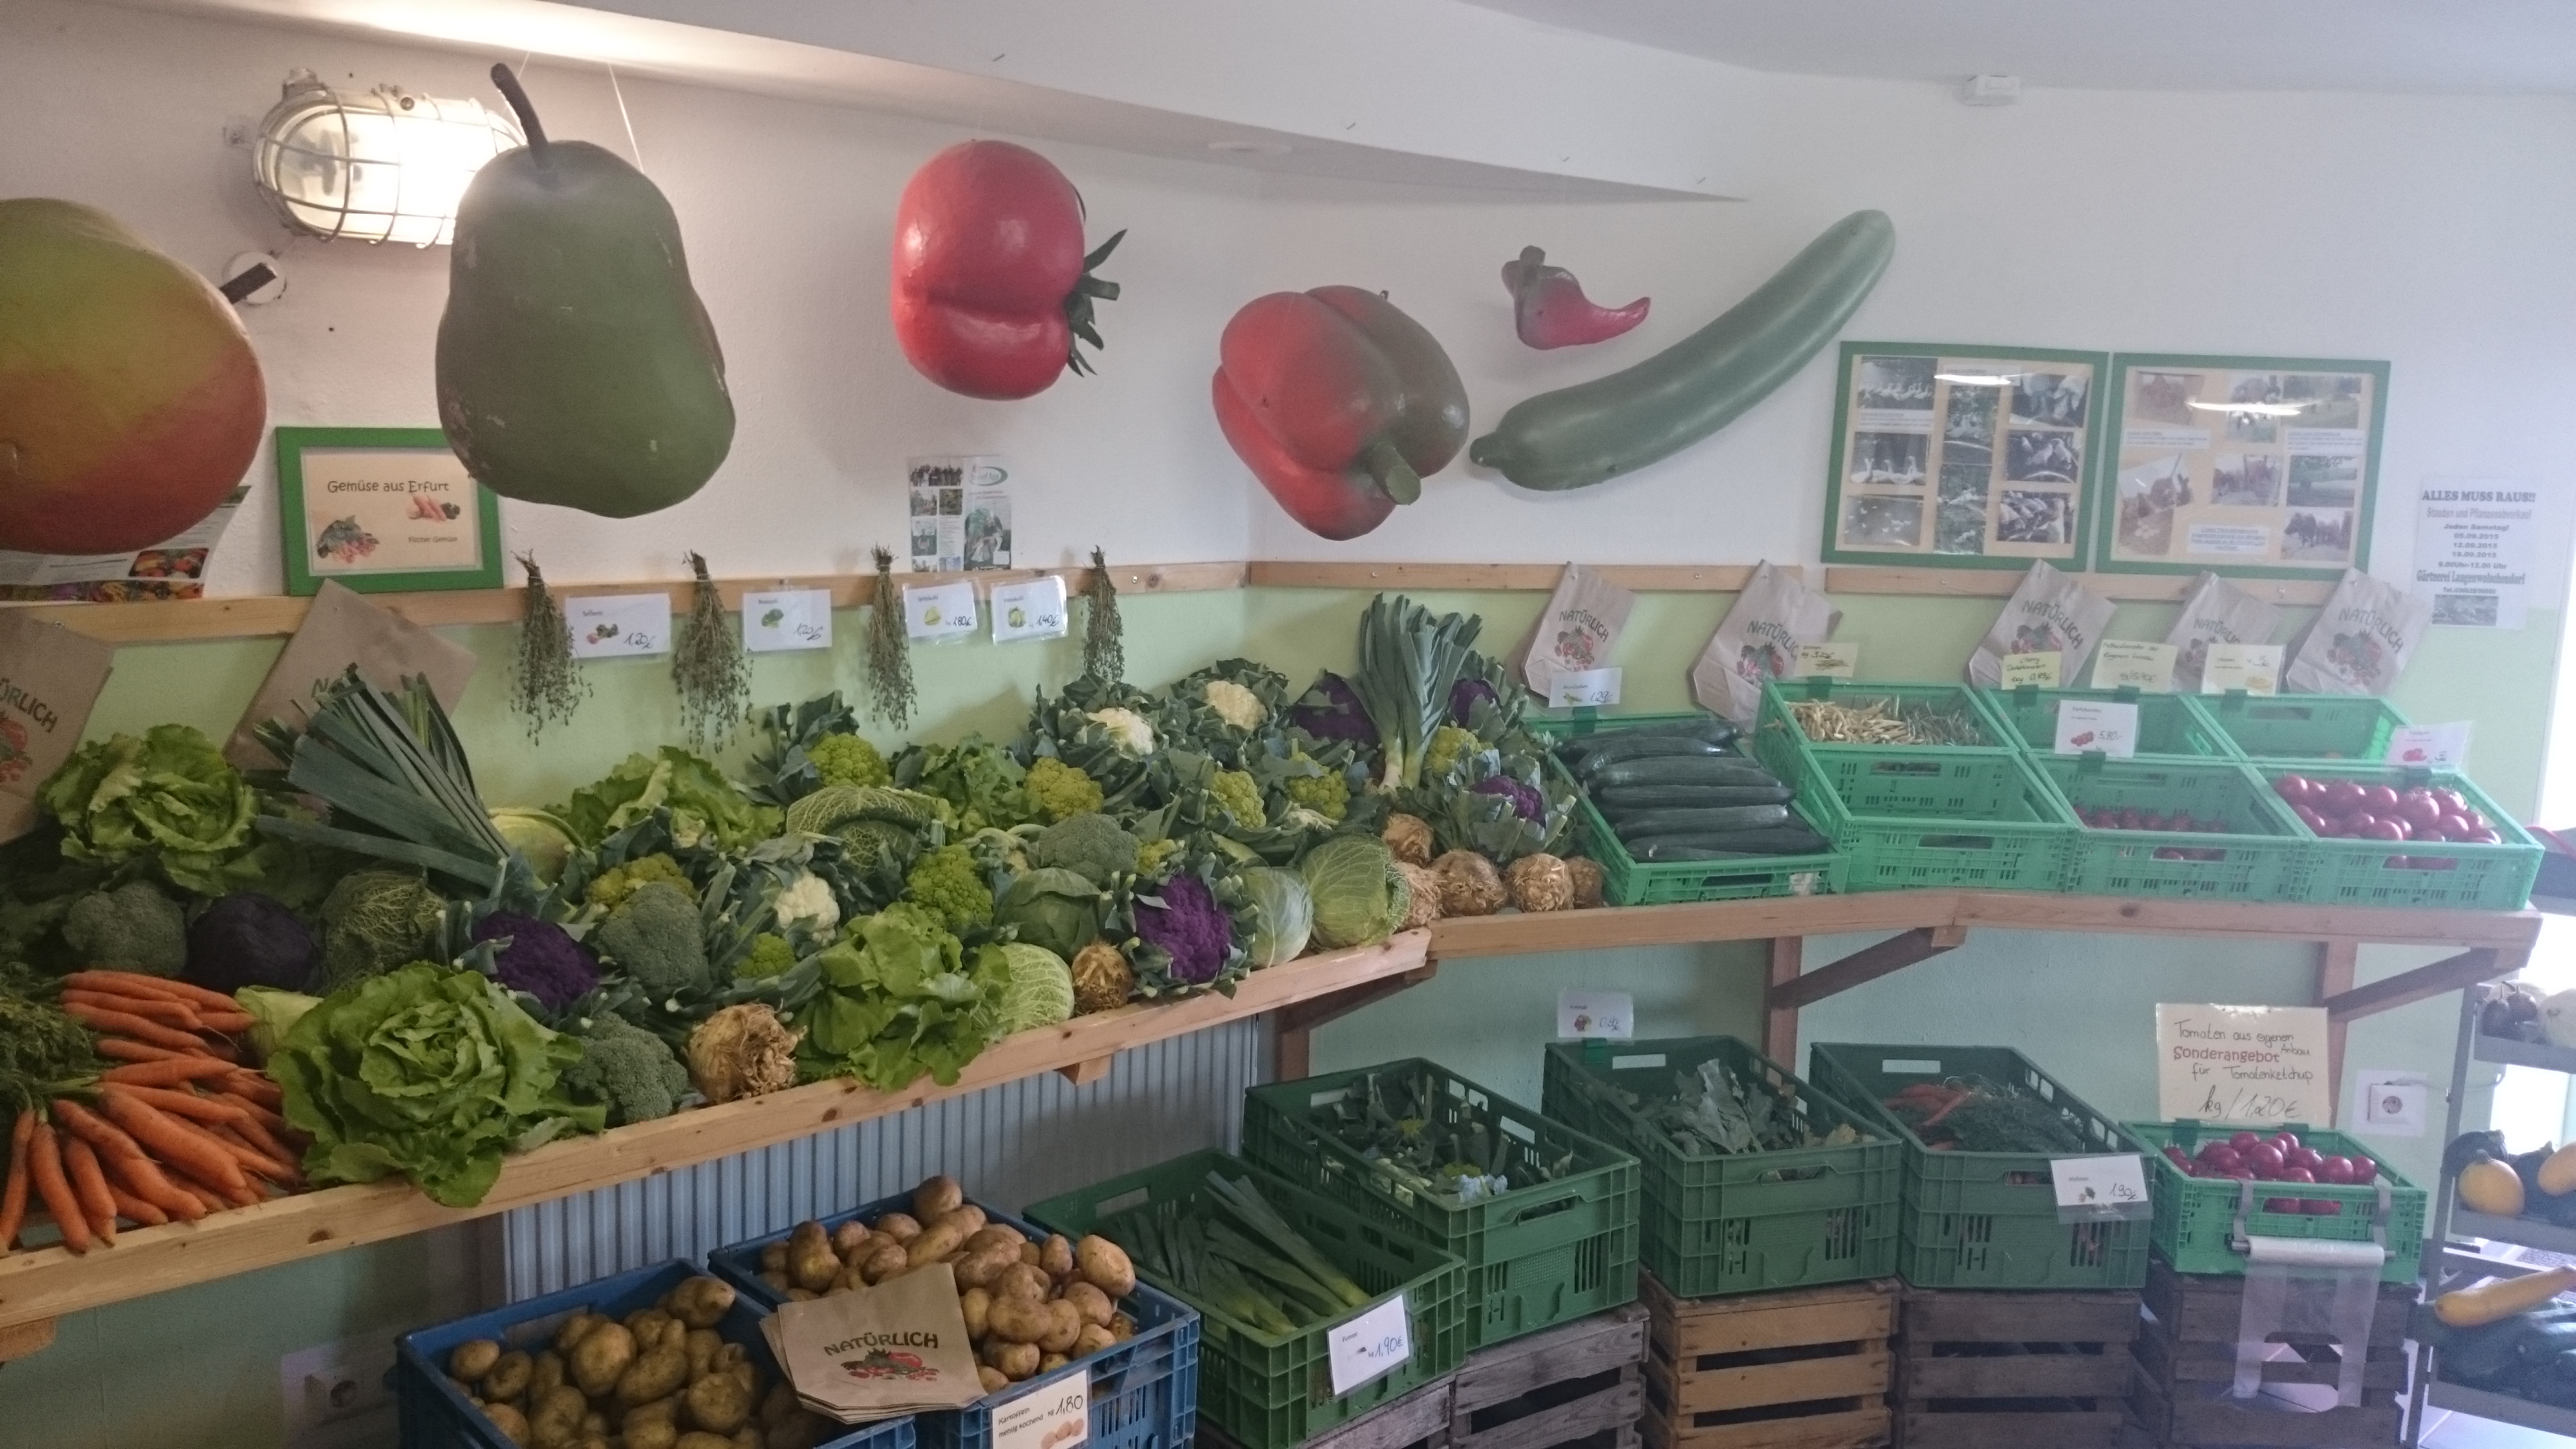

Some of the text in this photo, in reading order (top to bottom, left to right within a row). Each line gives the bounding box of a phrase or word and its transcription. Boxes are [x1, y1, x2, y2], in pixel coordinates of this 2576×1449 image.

[327, 480, 450, 493] Gemüse aus Erfurt
[2422, 490, 2536, 502] ALLES MUSS RAUS!!
[2455, 508, 2469, 519] und
[2416, 570, 2451, 582] Gärtnerei
[1559, 609, 1609, 643] NATÜRLICH
[2021, 600, 2084, 650] NATÜRLICH
[2194, 617, 2241, 644] NATÜRLI
[2338, 607, 2404, 654] NATÜRLICH
[1746, 620, 1799, 662] NATÜRLIC
[2174, 1018, 2294, 1048] Tomaten aus eigenem
[2174, 1046, 2280, 1063] Sonderangebot
[2282, 1043, 2310, 1056] Anbau
[2191, 1063, 2314, 1085] für Tomatenketchup
[823, 1332, 939, 1356] NATÜRLICH
[1375, 1336, 1403, 1358] 1,90€
[998, 1407, 1030, 1425] Kartoffeln
[1055, 1395, 1083, 1415] 1,80
[998, 1413, 1044, 1438] mehlig kochend
